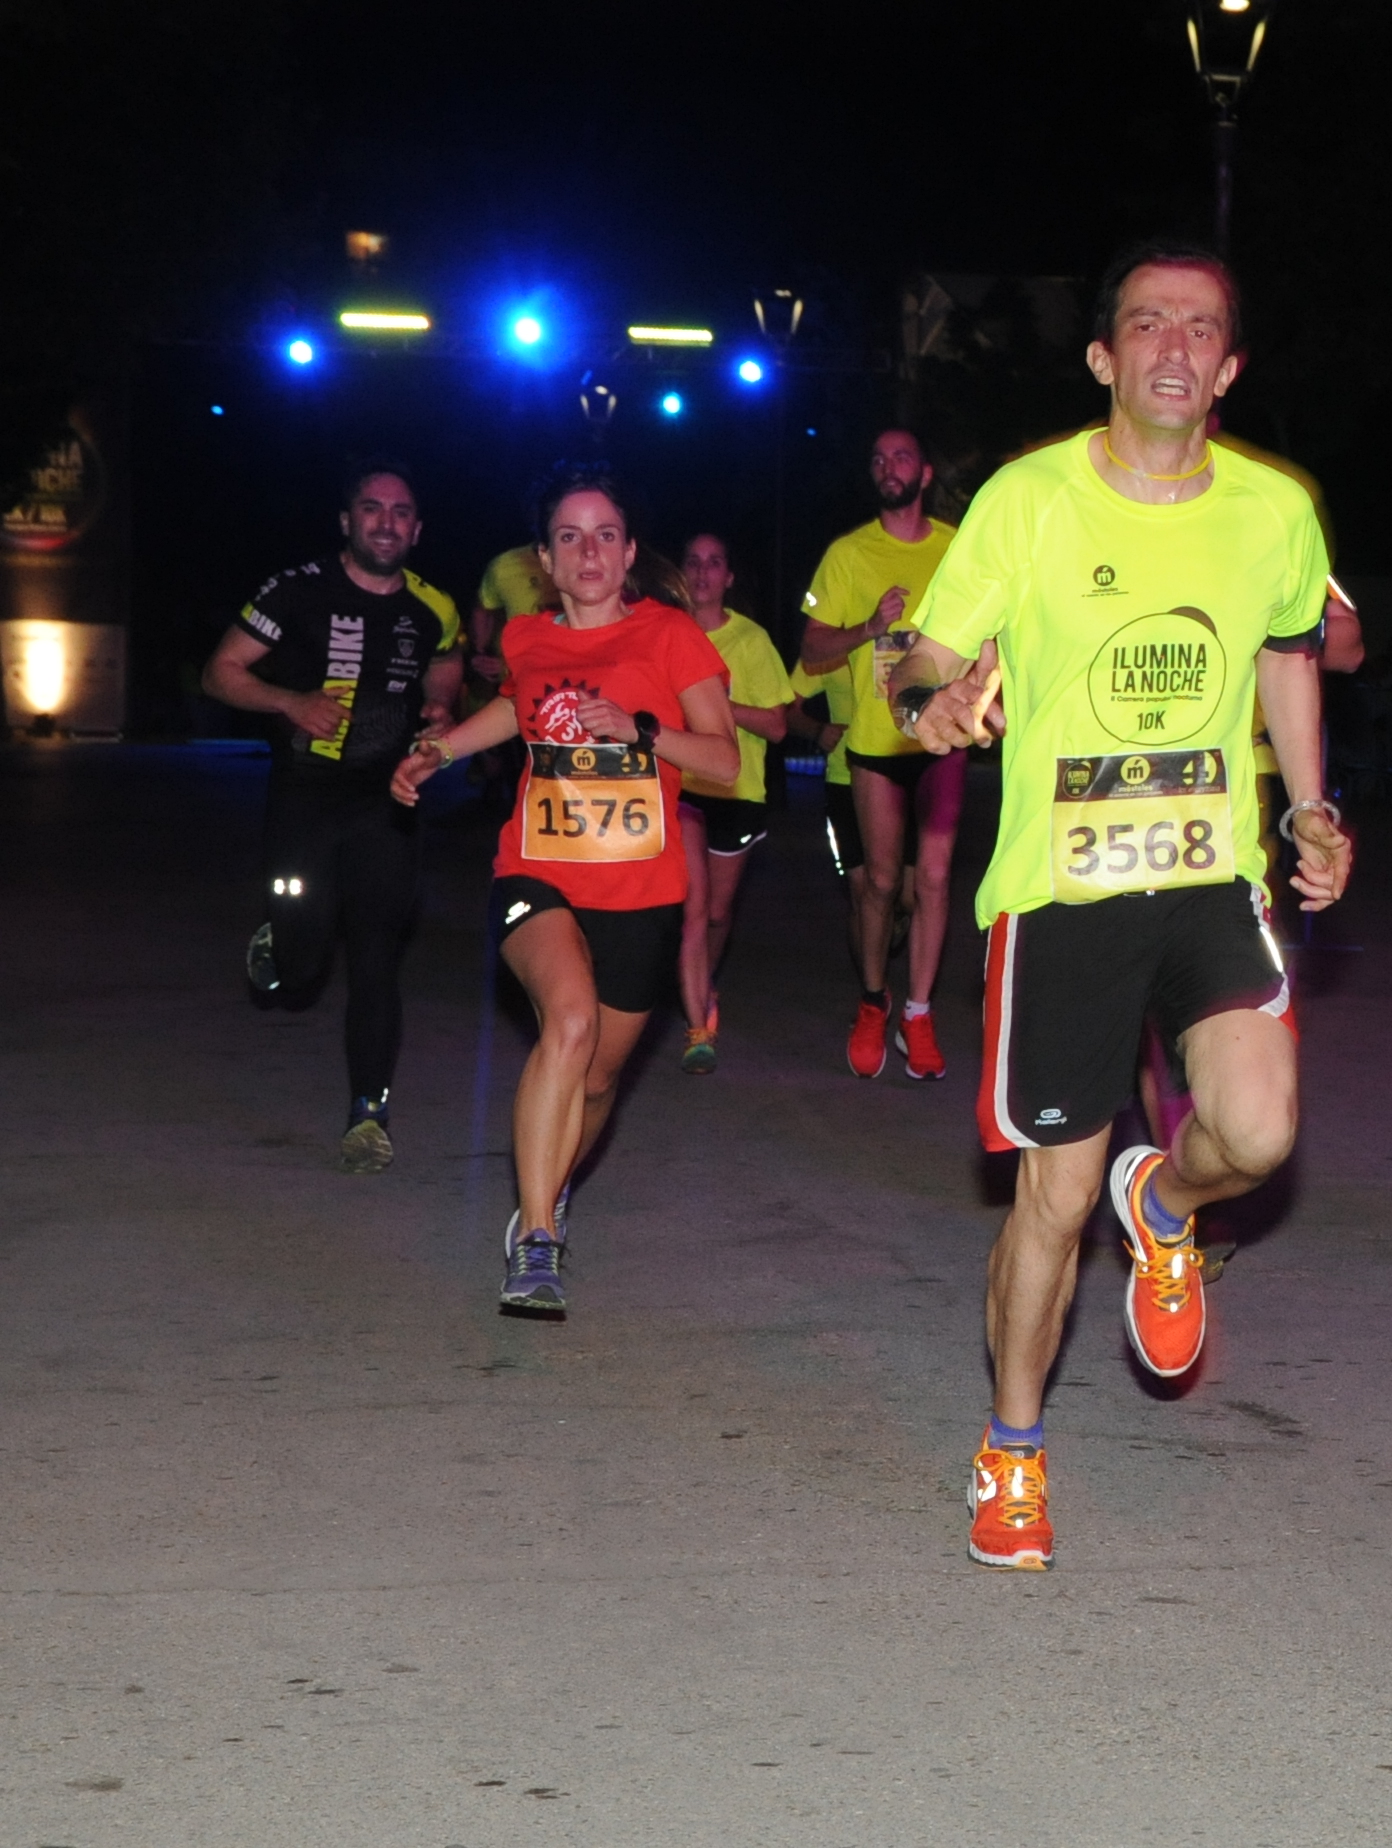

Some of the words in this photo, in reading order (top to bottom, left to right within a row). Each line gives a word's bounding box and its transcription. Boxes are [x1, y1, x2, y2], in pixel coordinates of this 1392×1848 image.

[1112, 643, 1207, 670] ILUMINA
[1137, 710, 1166, 731] 10K
[537, 798, 649, 838] 1576
[1067, 820, 1217, 876] 3568
